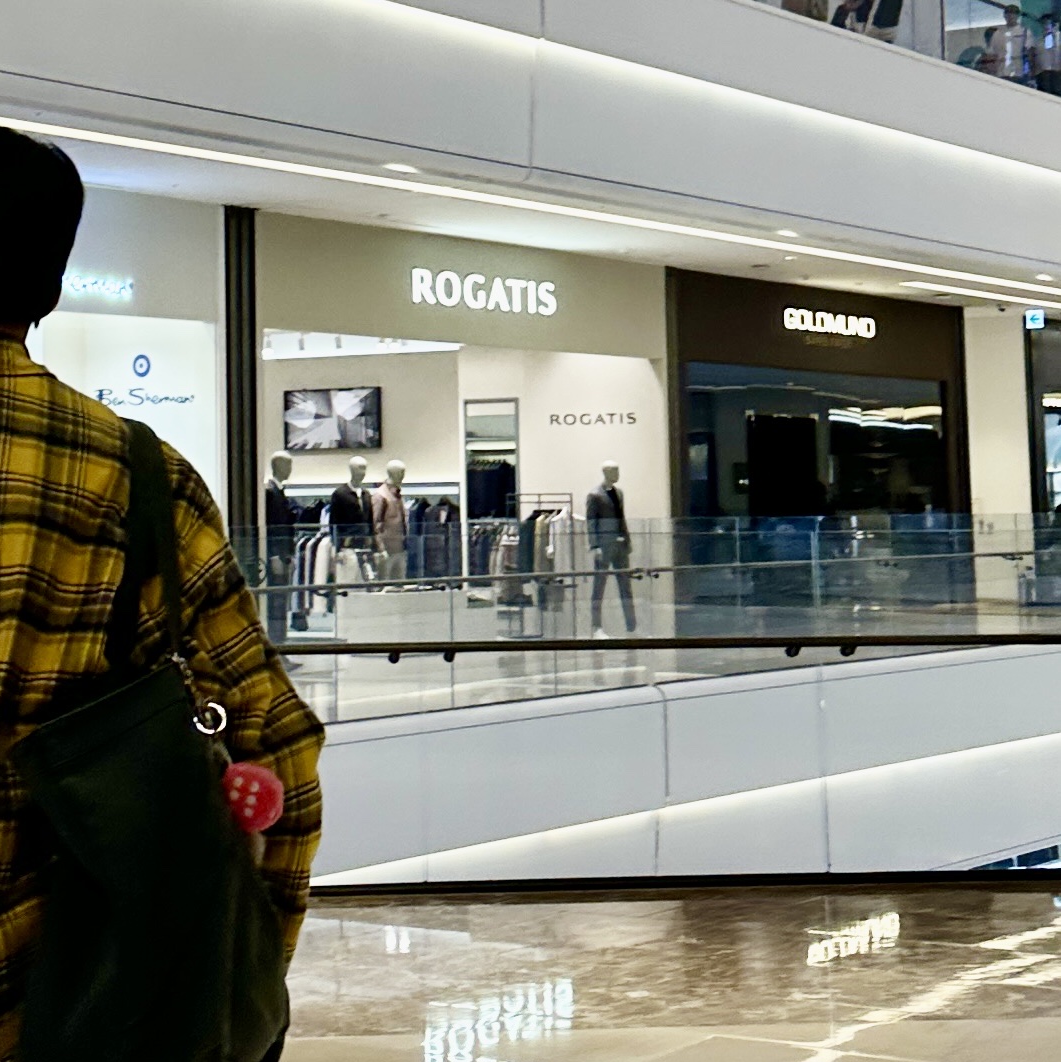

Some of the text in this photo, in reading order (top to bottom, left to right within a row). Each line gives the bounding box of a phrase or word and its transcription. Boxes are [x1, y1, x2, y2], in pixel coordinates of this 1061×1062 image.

[411, 267, 558, 316] ROGATIS
[783, 307, 876, 339] GOLDMUND
[549, 412, 637, 426] ROGATIS
